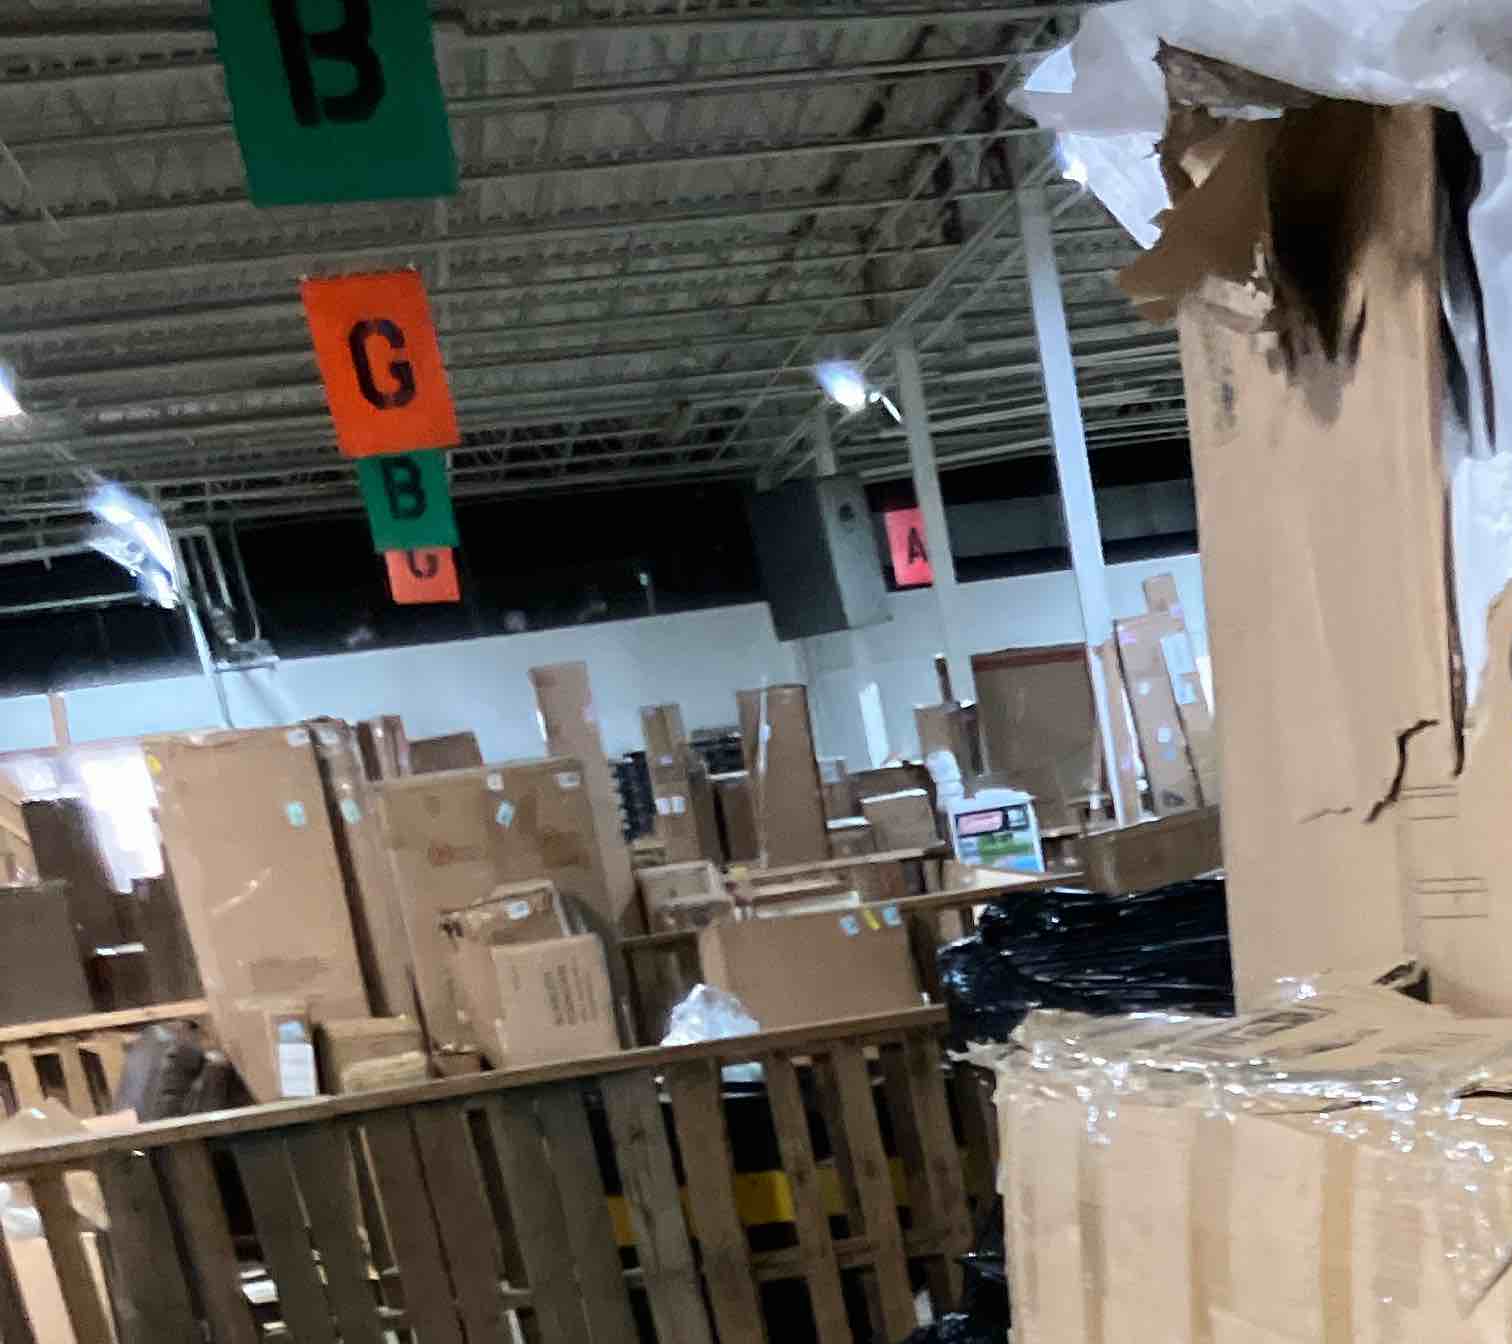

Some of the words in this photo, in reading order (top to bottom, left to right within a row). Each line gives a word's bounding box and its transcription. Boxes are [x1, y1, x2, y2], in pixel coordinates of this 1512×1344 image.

[270, 0, 386, 127] B
[349, 318, 416, 411] G
[380, 457, 427, 520] B
[908, 528, 928, 564] A
